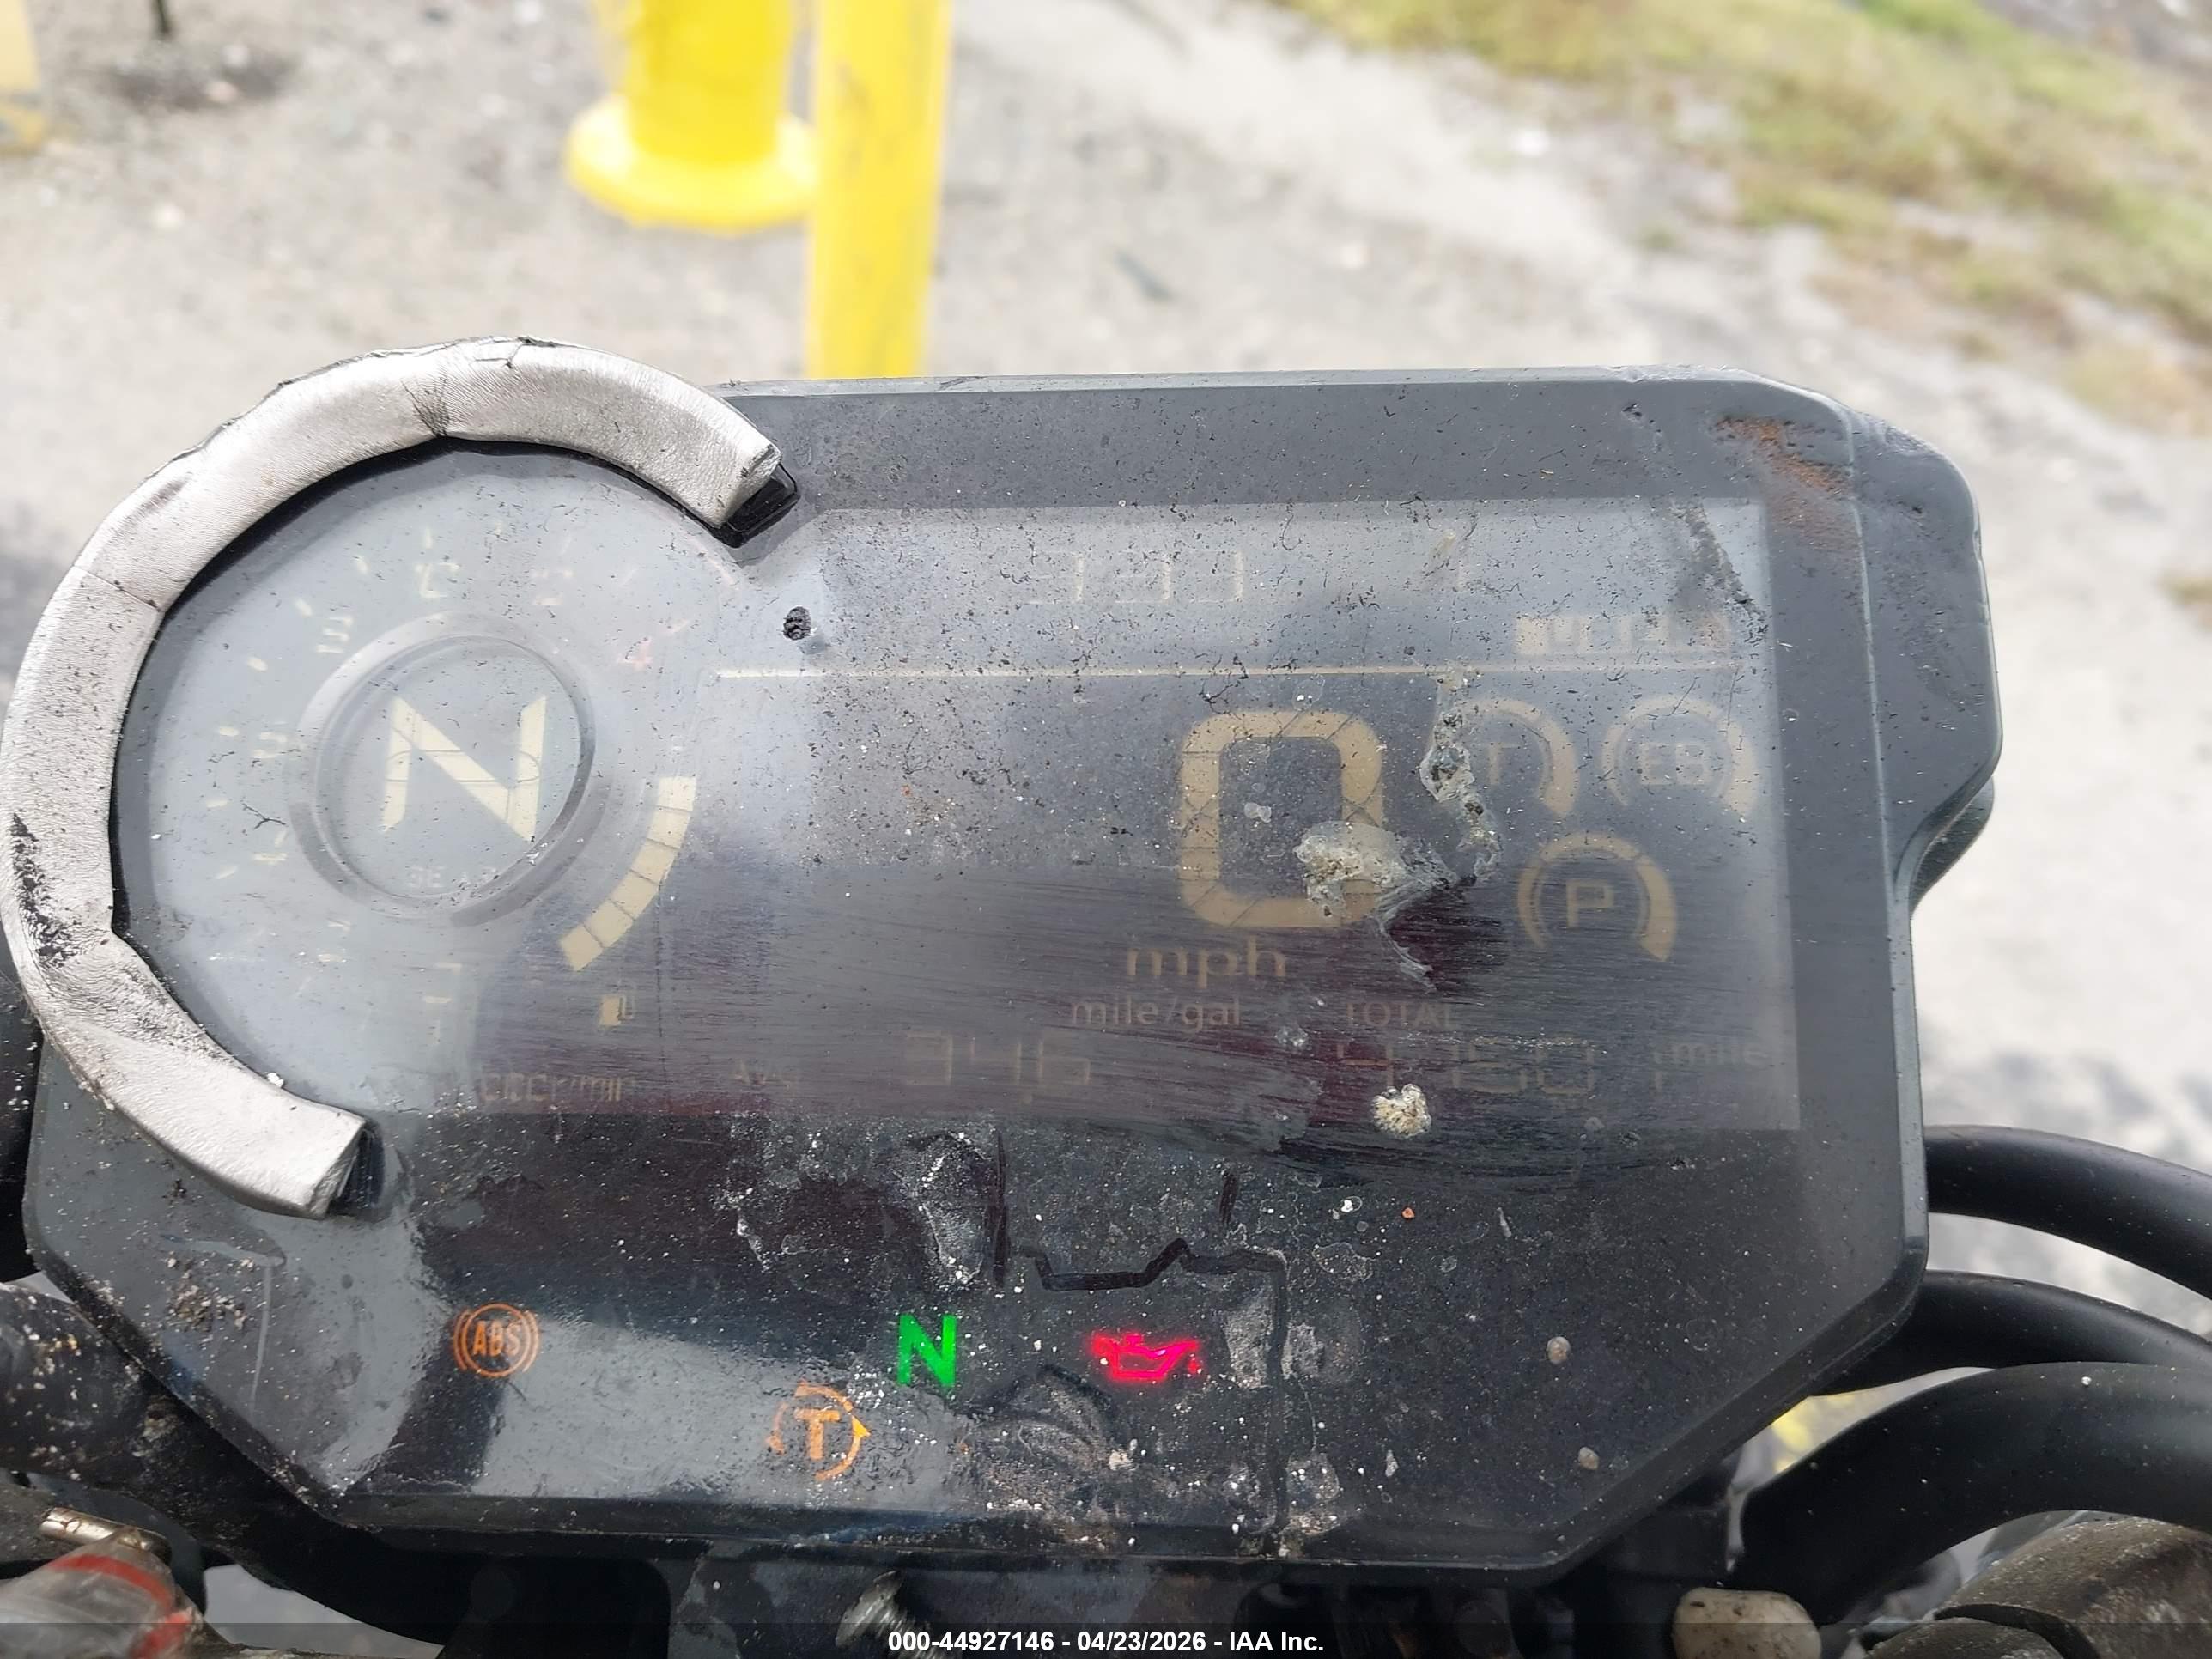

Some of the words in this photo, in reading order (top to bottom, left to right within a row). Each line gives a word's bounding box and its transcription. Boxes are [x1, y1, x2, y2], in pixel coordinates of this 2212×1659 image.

[379, 693, 547, 844] N
[1180, 711, 1382, 927] 0
[1565, 878, 1615, 928] P
[1127, 938, 1286, 991] mph
[1071, 994, 1240, 1031] mile/gal
[1345, 1002, 1458, 1029] TOTAL
[472, 1319, 521, 1357] ABS
[897, 1314, 957, 1388] N
[793, 1408, 841, 1462] T
